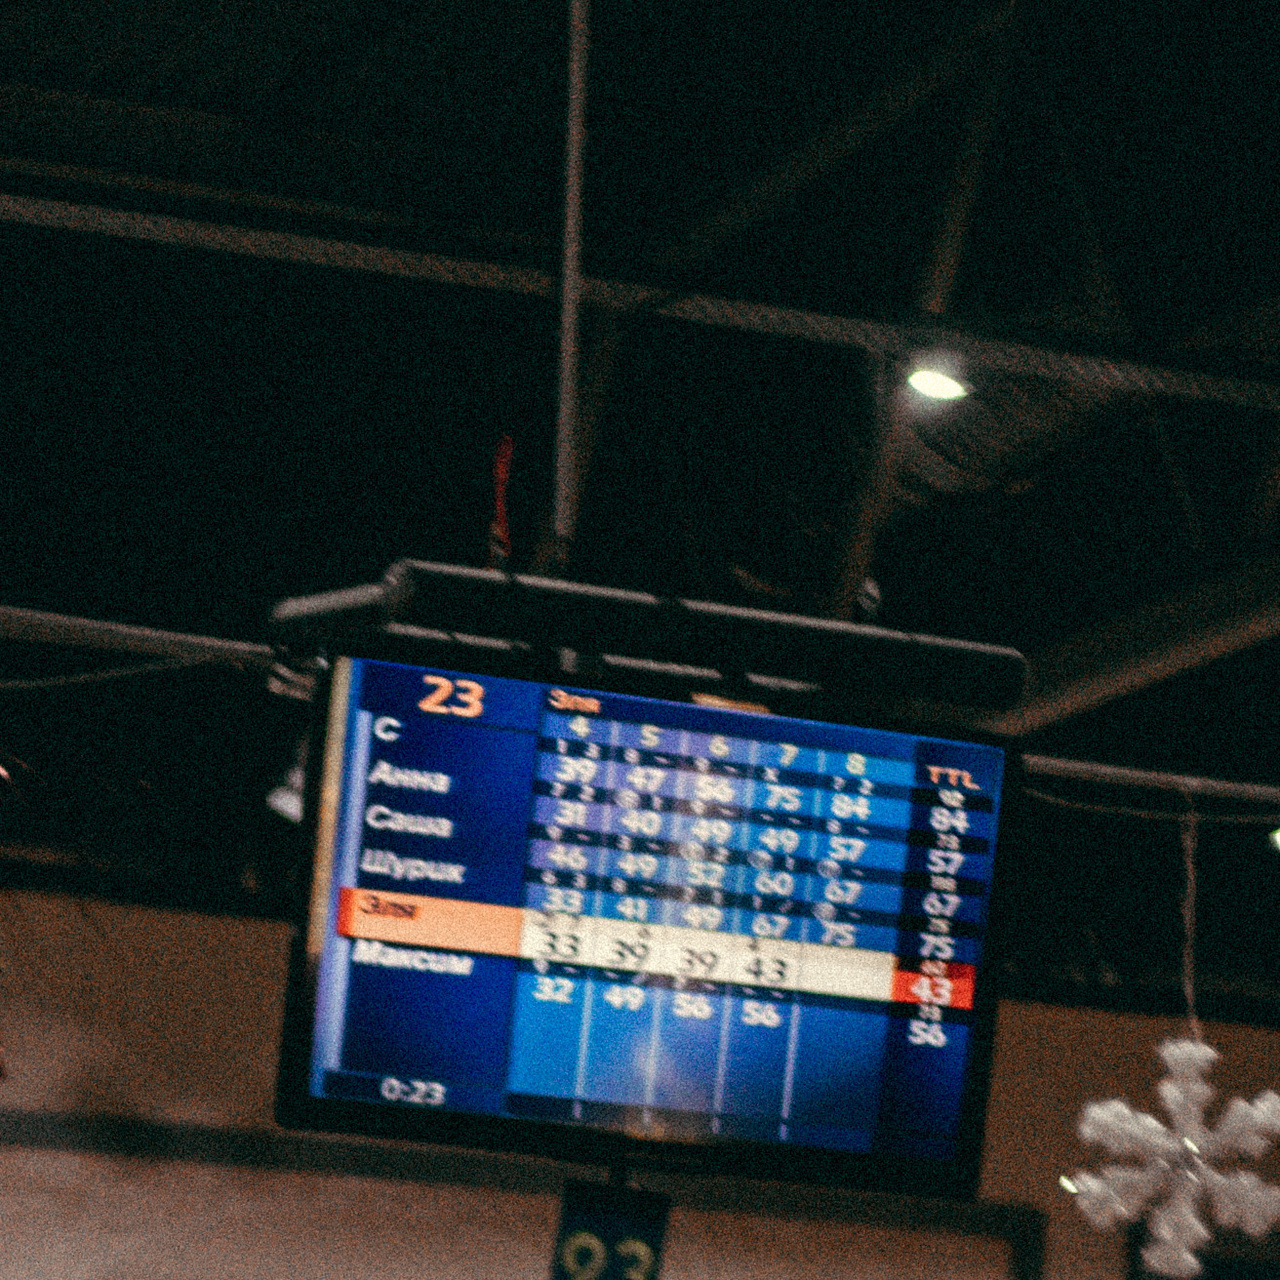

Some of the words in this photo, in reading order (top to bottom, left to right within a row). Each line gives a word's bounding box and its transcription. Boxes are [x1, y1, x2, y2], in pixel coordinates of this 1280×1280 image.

[417, 674, 485, 719] 23
[626, 765, 667, 793] 47
[531, 975, 576, 1005] 32
[909, 976, 954, 1008] 43
